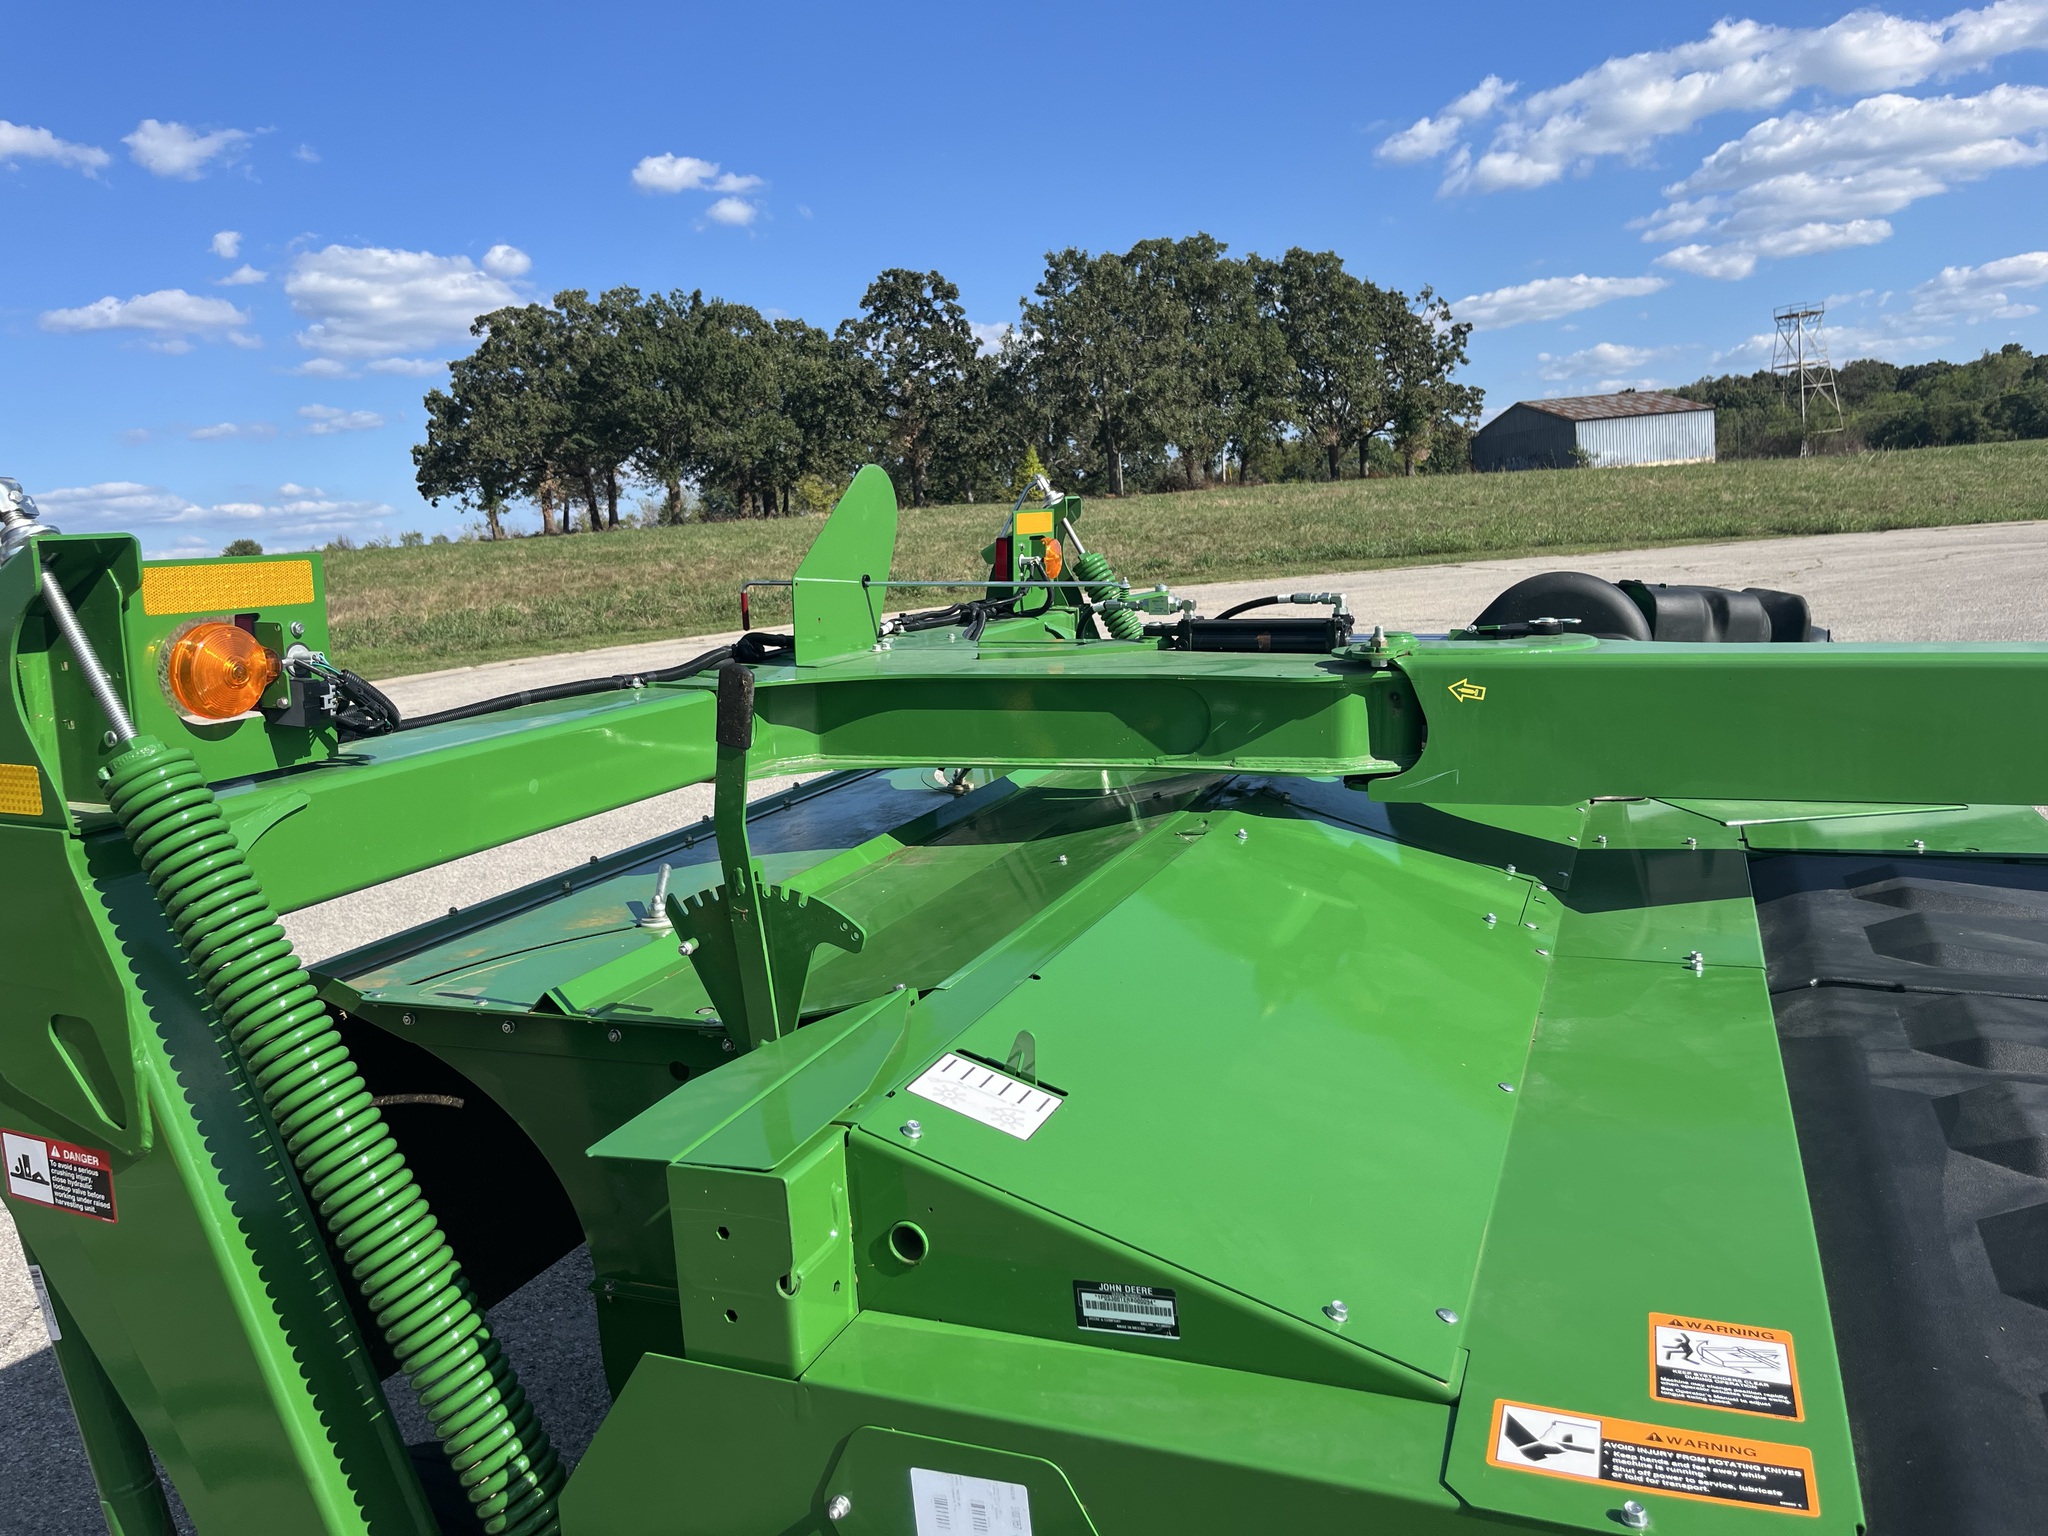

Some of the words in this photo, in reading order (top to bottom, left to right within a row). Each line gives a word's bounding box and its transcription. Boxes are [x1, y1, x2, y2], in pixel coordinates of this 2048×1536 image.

[63, 1150, 99, 1166] DANGER
[50, 1159, 57, 1167] To
[58, 1162, 72, 1171] avoid
[78, 1167, 99, 1177] serious
[51, 1168, 75, 1180] crushing
[52, 1176, 67, 1184] close
[67, 1179, 93, 1190] hydraulic
[53, 1182, 71, 1194] lockup
[72, 1188, 87, 1196] valve
[87, 1190, 106, 1200] before
[54, 1191, 76, 1202] working
[76, 1196, 92, 1204] under
[93, 1200, 111, 1209] raised
[55, 1197, 84, 1211] harvesting
[84, 1205, 97, 1213] unit.
[1099, 1283, 1122, 1293] JOHN
[1125, 1285, 1153, 1295] DEERE
[1686, 1320, 1775, 1340] WARNING
[1660, 1376, 1689, 1385] Machine
[1706, 1384, 1732, 1392] change
[1733, 1388, 1762, 1396] position
[1763, 1392, 1788, 1400] rapidly
[1680, 1384, 1710, 1392] operator
[1684, 1374, 1713, 1383] DURING
[1714, 1379, 1758, 1390] OPERATION
[1693, 1372, 1743, 1383] BYSTANDERS
[1743, 1380, 1769, 1388] CLEAR
[1660, 1390, 1685, 1398] tongue
[1686, 1394, 1708, 1402] swing
[1713, 1394, 1739, 1402] Manual
[1666, 1435, 1757, 1457] WARNING
[1603, 1441, 1635, 1452] AVOID
[1637, 1446, 1674, 1459] INJURY
[1676, 1453, 1706, 1464] FROM
[1708, 1458, 1761, 1472] ROTATING
[1763, 1465, 1802, 1477] KNIVES
[1612, 1457, 1653, 1469] machine
[1666, 1467, 1707, 1478] running.
[1613, 1450, 1638, 1460] Keep
[1640, 1455, 1670, 1466] hands
[1671, 1460, 1690, 1469] and
[1692, 1463, 1711, 1472] feet
[1712, 1468, 1738, 1477] away
[1740, 1472, 1767, 1480] while
[1612, 1464, 1636, 1474] Shut
[1637, 1468, 1652, 1477] off
[1653, 1472, 1684, 1482] power
[1698, 1479, 1737, 1491] service,
[1738, 1484, 1783, 1497] lubricate
[1624, 1473, 1644, 1483] fold
[1645, 1476, 1661, 1485] for
[1662, 1479, 1711, 1493] transport.
